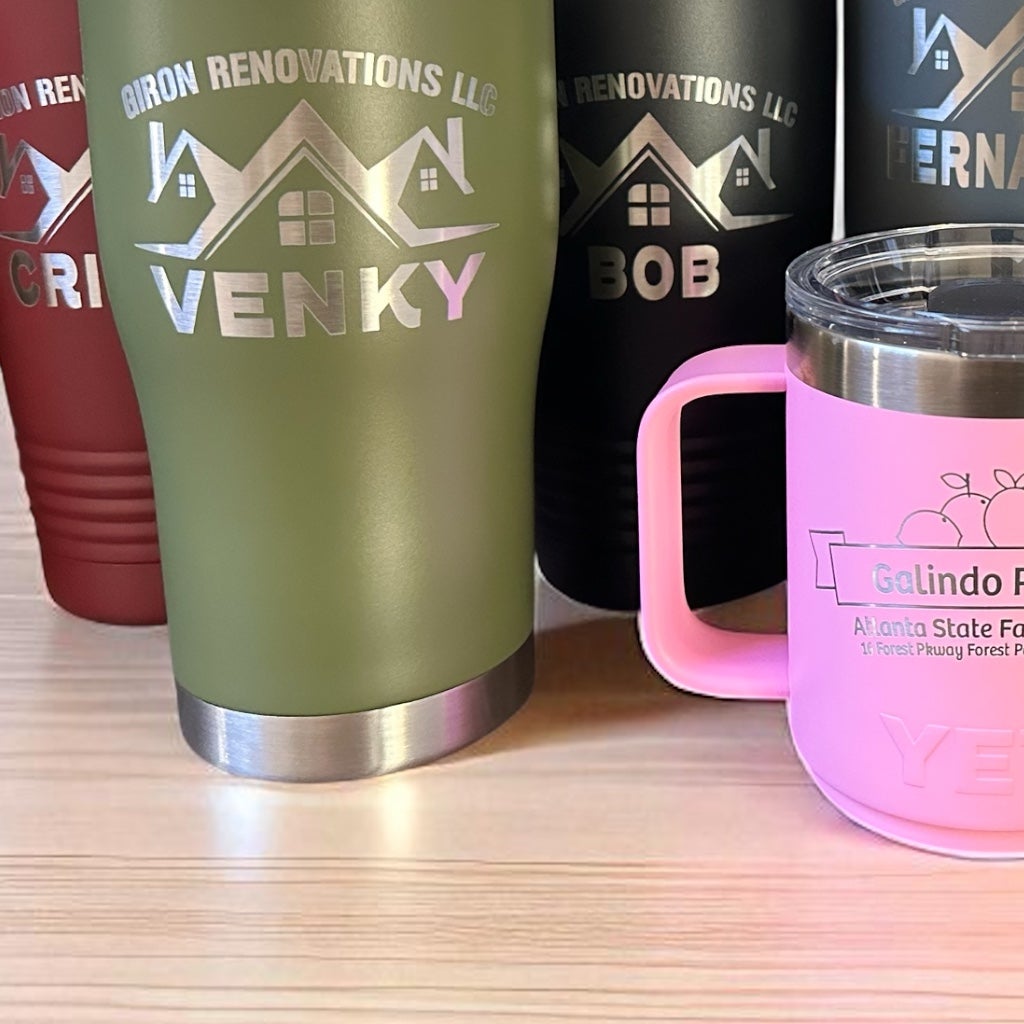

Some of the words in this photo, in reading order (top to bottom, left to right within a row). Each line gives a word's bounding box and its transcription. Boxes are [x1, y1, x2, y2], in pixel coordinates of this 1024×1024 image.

[0, 82, 32, 121] ON
[121, 59, 200, 120] GIRON
[207, 48, 442, 98] RENOVATIONS
[451, 71, 498, 117] LLC
[574, 72, 757, 112] RENOVATIONS
[762, 92, 798, 127] LLC
[9, 249, 103, 310] CRI
[150, 252, 486, 338] VENKY
[588, 245, 720, 301] BOB
[871, 563, 1002, 597] Galindo
[854, 616, 927, 638] Atlanta
[932, 618, 992, 638] State
[876, 641, 914, 656] Forest
[916, 642, 963, 661] Pkway
[967, 642, 1010, 656] Forest
